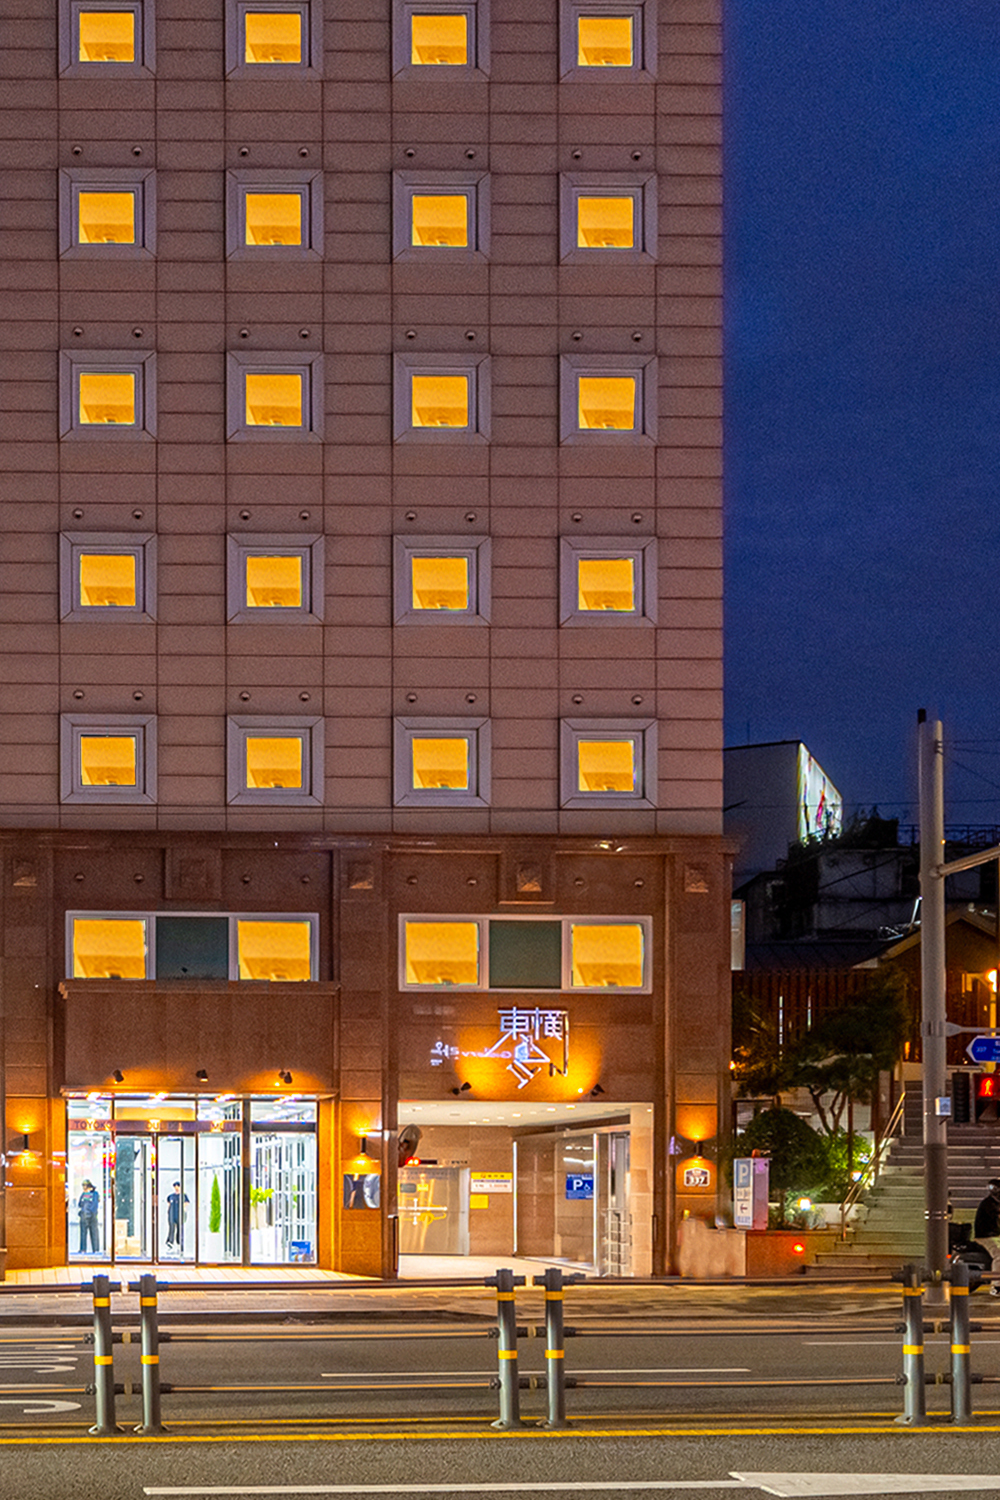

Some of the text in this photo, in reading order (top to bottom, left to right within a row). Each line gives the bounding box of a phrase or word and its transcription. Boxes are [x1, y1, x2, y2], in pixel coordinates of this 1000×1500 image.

[74, 1121, 114, 1131] TOYOKO
[738, 1163, 749, 1185] P
[573, 1179, 584, 1191] P
